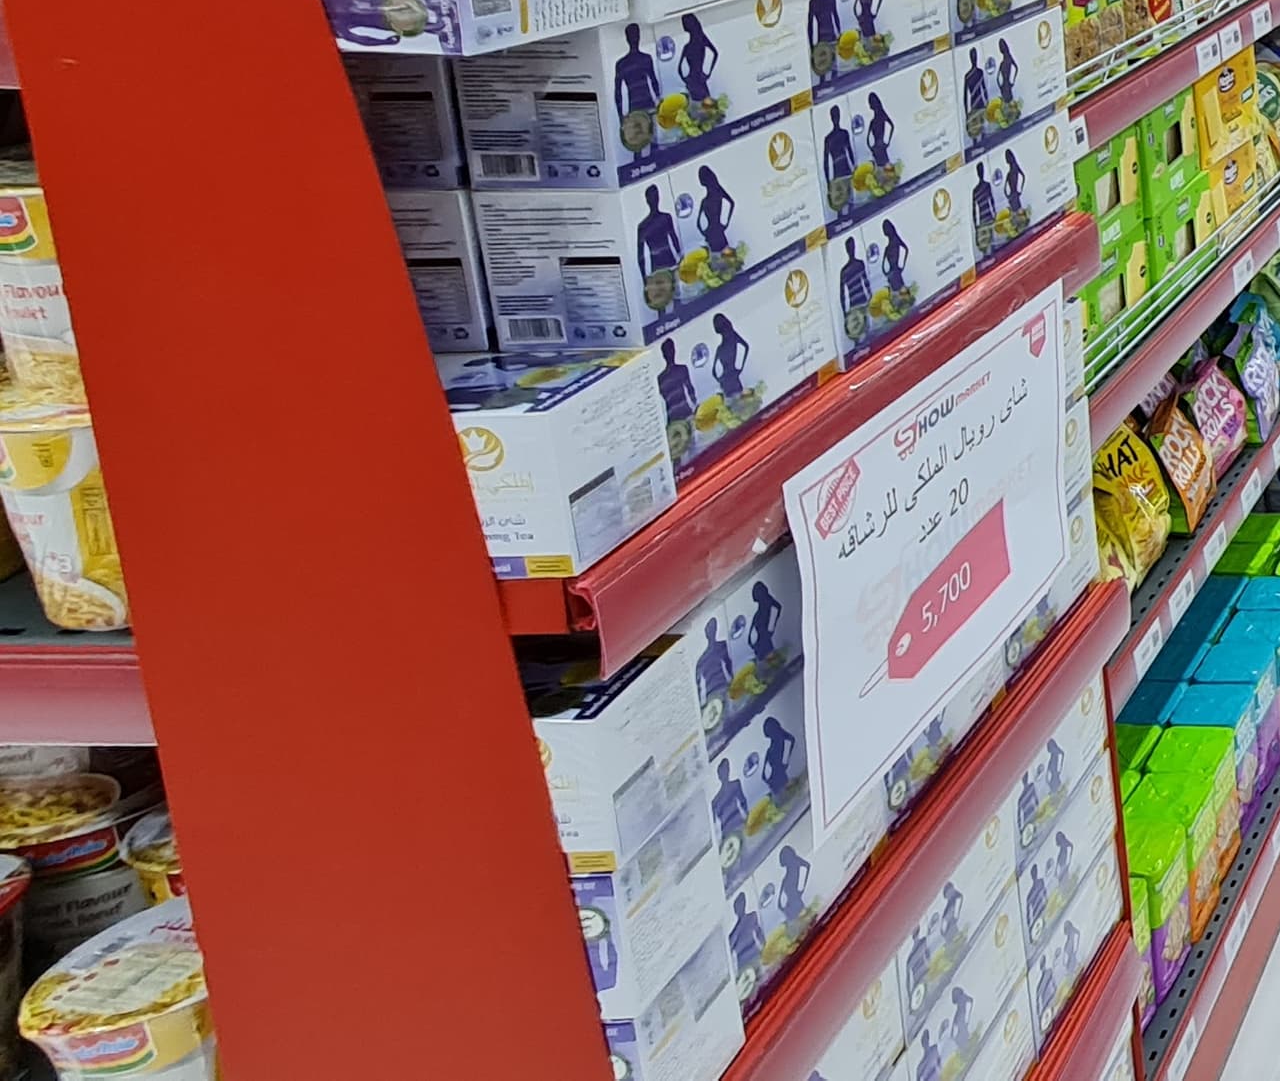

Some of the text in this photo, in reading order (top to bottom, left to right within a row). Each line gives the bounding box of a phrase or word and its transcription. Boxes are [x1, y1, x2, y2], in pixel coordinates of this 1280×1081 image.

[894, 370, 992, 460] SHOW MARKET
[918, 478, 969, 544] 20 عدد
[920, 560, 972, 634] 5,700
